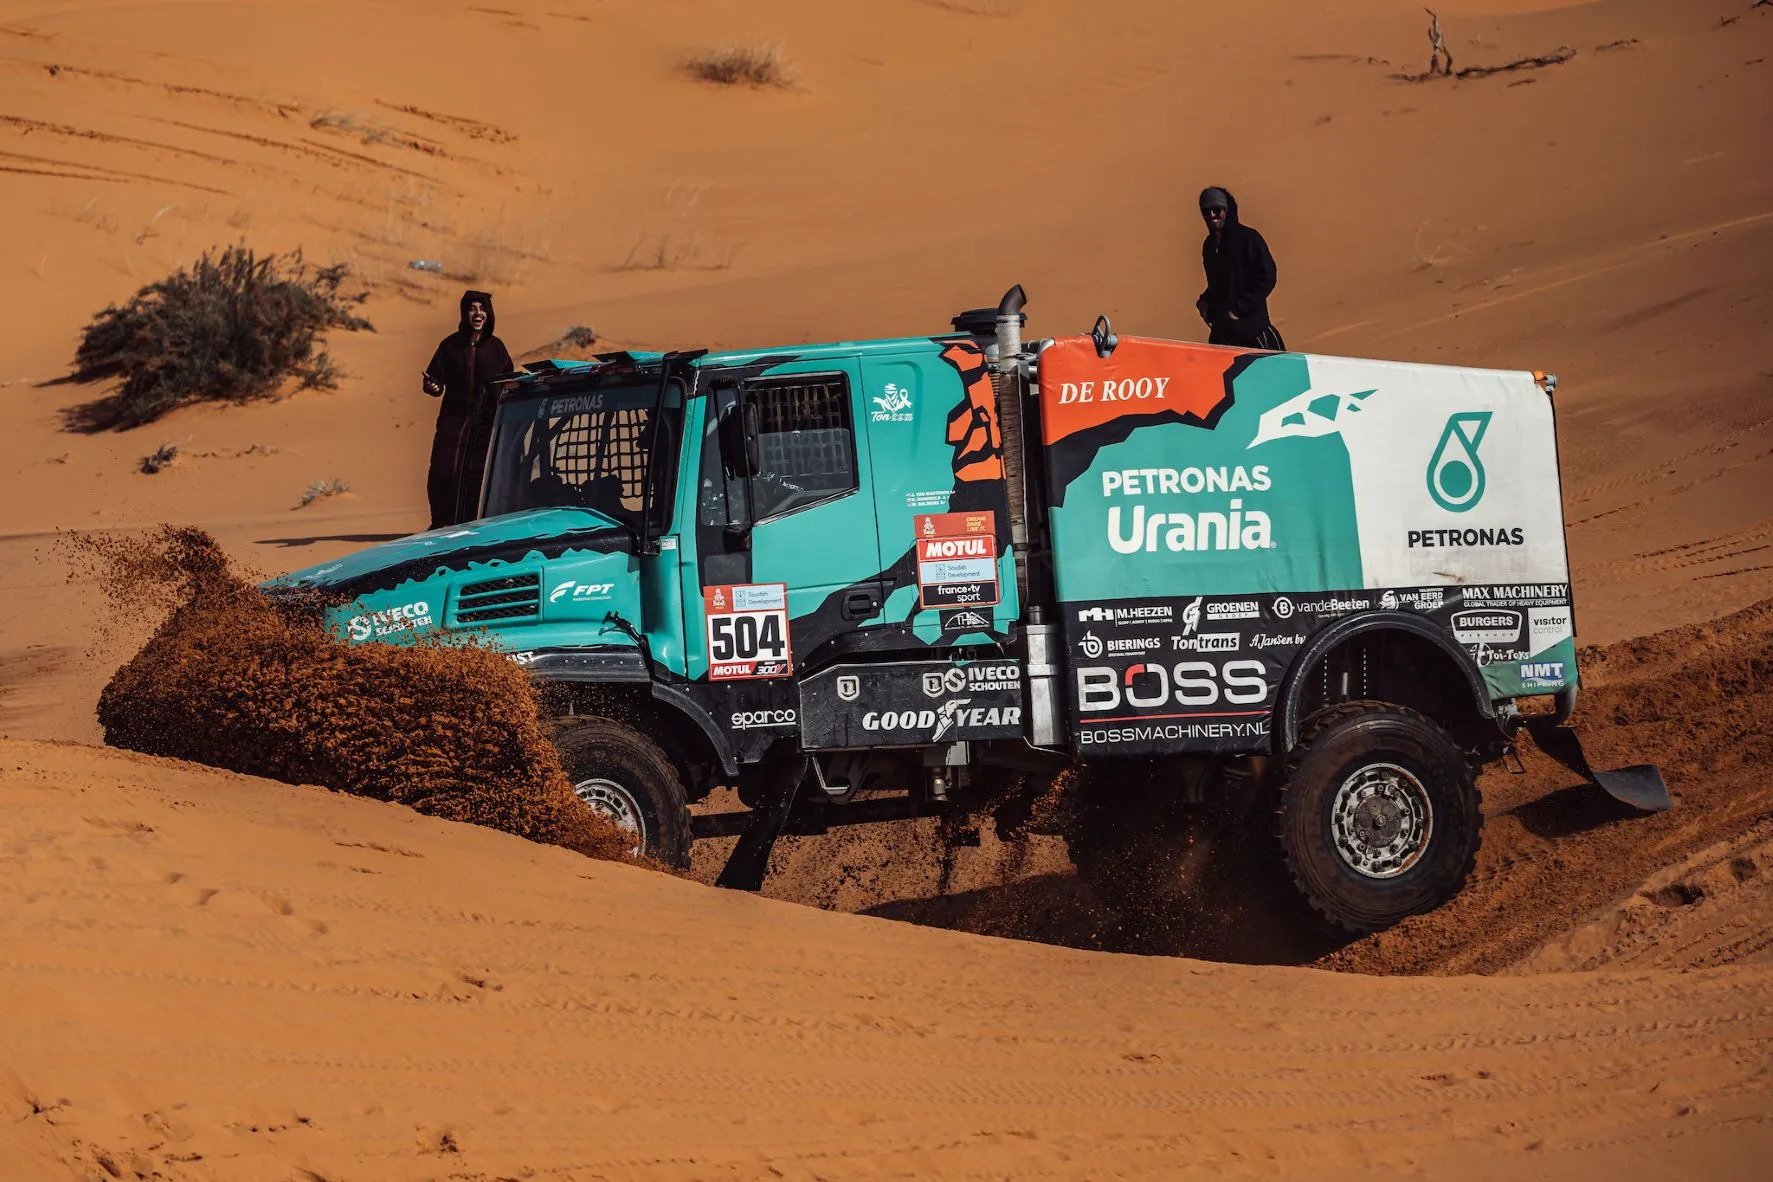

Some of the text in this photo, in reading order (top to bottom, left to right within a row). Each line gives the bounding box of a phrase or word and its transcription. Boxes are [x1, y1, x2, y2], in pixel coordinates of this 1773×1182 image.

[1058, 377, 1170, 405] DE ROOY
[550, 394, 603, 415] PETRONAS
[871, 411, 891, 423] Ton
[1102, 464, 1272, 497] PETRONAS
[1106, 498, 1273, 554] Urania
[1407, 527, 1524, 548] PETRONAS
[926, 539, 987, 558] MOTUL
[573, 584, 615, 596] FPT
[1399, 592, 1444, 602] VAN EERD
[1461, 584, 1568, 600] MAX MACHINERY
[957, 594, 981, 604] sport
[1297, 598, 1370, 613] vandeBeeten
[1414, 600, 1444, 610] GROEP
[1517, 599, 1535, 607] HEAVY
[1535, 598, 1567, 606] EQUIPMENT
[372, 602, 429, 626] IVECO
[1117, 606, 1173, 619] M.HEEZEN
[1206, 601, 1259, 613] GROENEN
[1459, 616, 1514, 628] BURGERS
[1534, 617, 1567, 626] visitor
[1533, 625, 1563, 634] control
[712, 615, 785, 660] 504
[1106, 637, 1161, 651] BIERINGS
[1487, 649, 1530, 661] Toi-Toys
[713, 664, 787, 675] MOTUL 300V
[968, 666, 1020, 681] IVECO
[1521, 663, 1563, 678] NMT
[968, 681, 1021, 692] SCHOUTEN
[1076, 659, 1267, 711] BOSS
[731, 709, 796, 730] sparco
[1080, 722, 1270, 744] BOSSMACHINERY.NL
